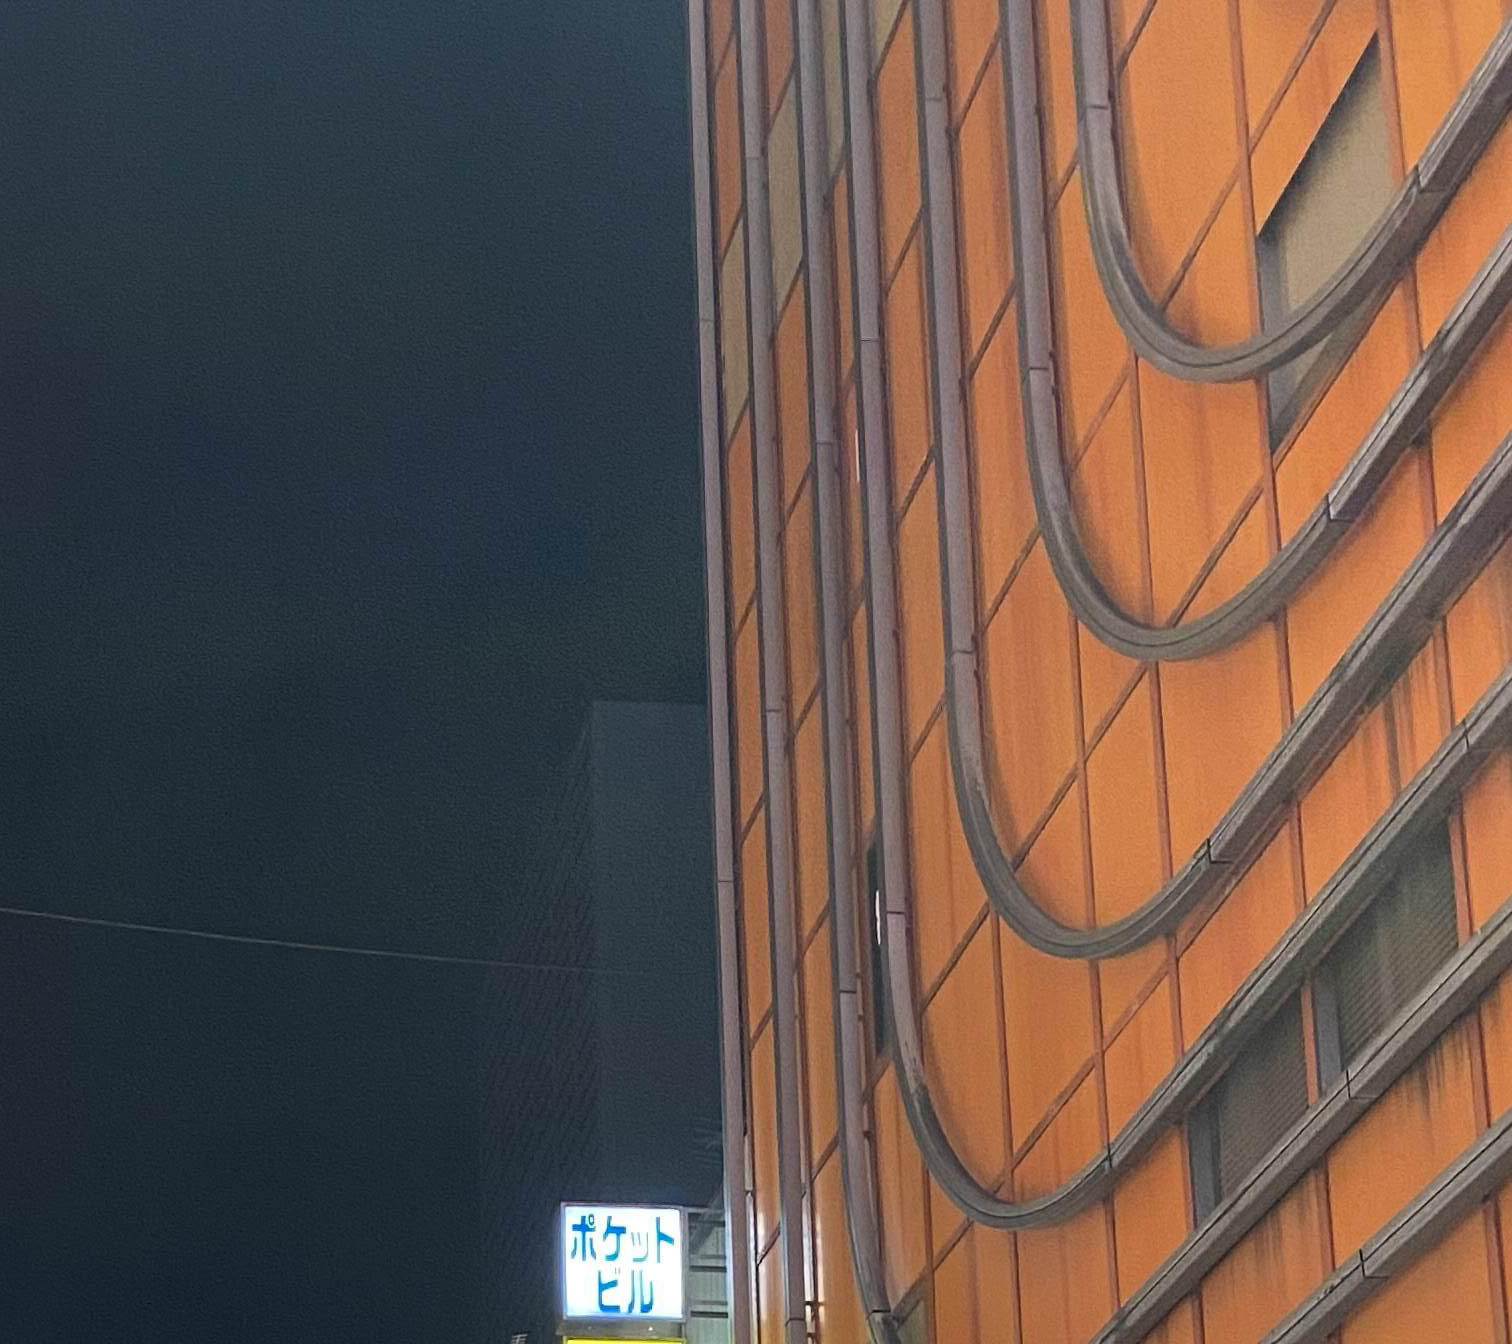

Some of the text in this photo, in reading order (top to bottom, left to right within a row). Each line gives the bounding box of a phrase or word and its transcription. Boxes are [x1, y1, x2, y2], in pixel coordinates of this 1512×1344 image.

[571, 1214, 675, 1263] ポケット
[598, 1268, 654, 1313] ビル
